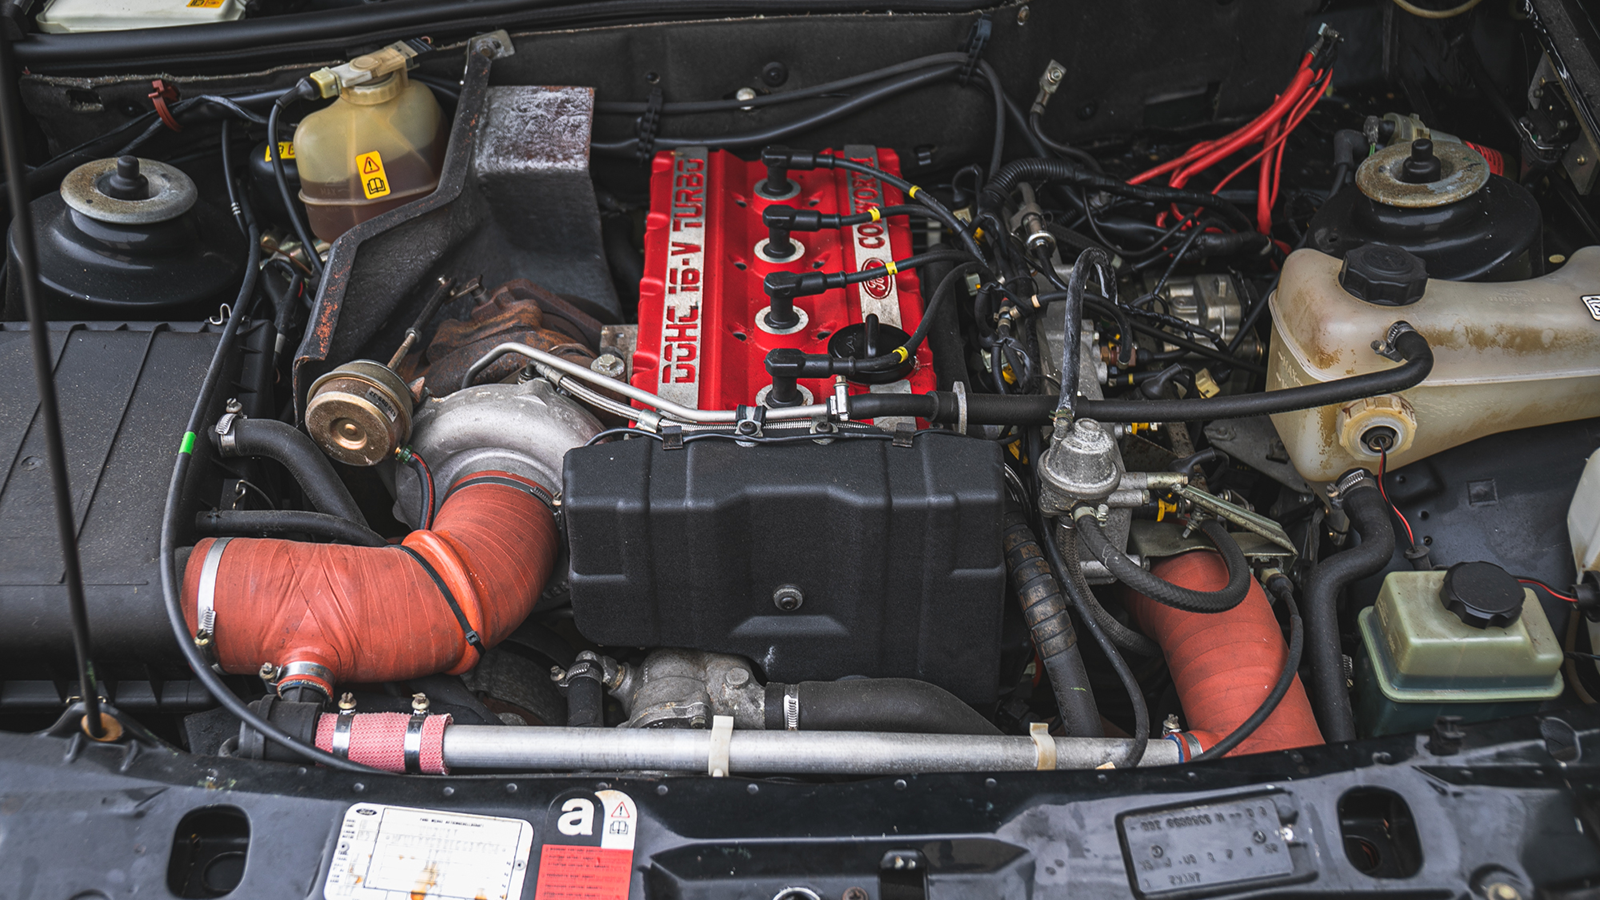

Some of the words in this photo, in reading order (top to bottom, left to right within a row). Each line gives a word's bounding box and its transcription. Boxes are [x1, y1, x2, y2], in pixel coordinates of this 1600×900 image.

[672, 158, 704, 232] TURBO
[850, 157, 885, 249] COWORH
[662, 303, 698, 384] DOHC
[557, 797, 595, 837] a
